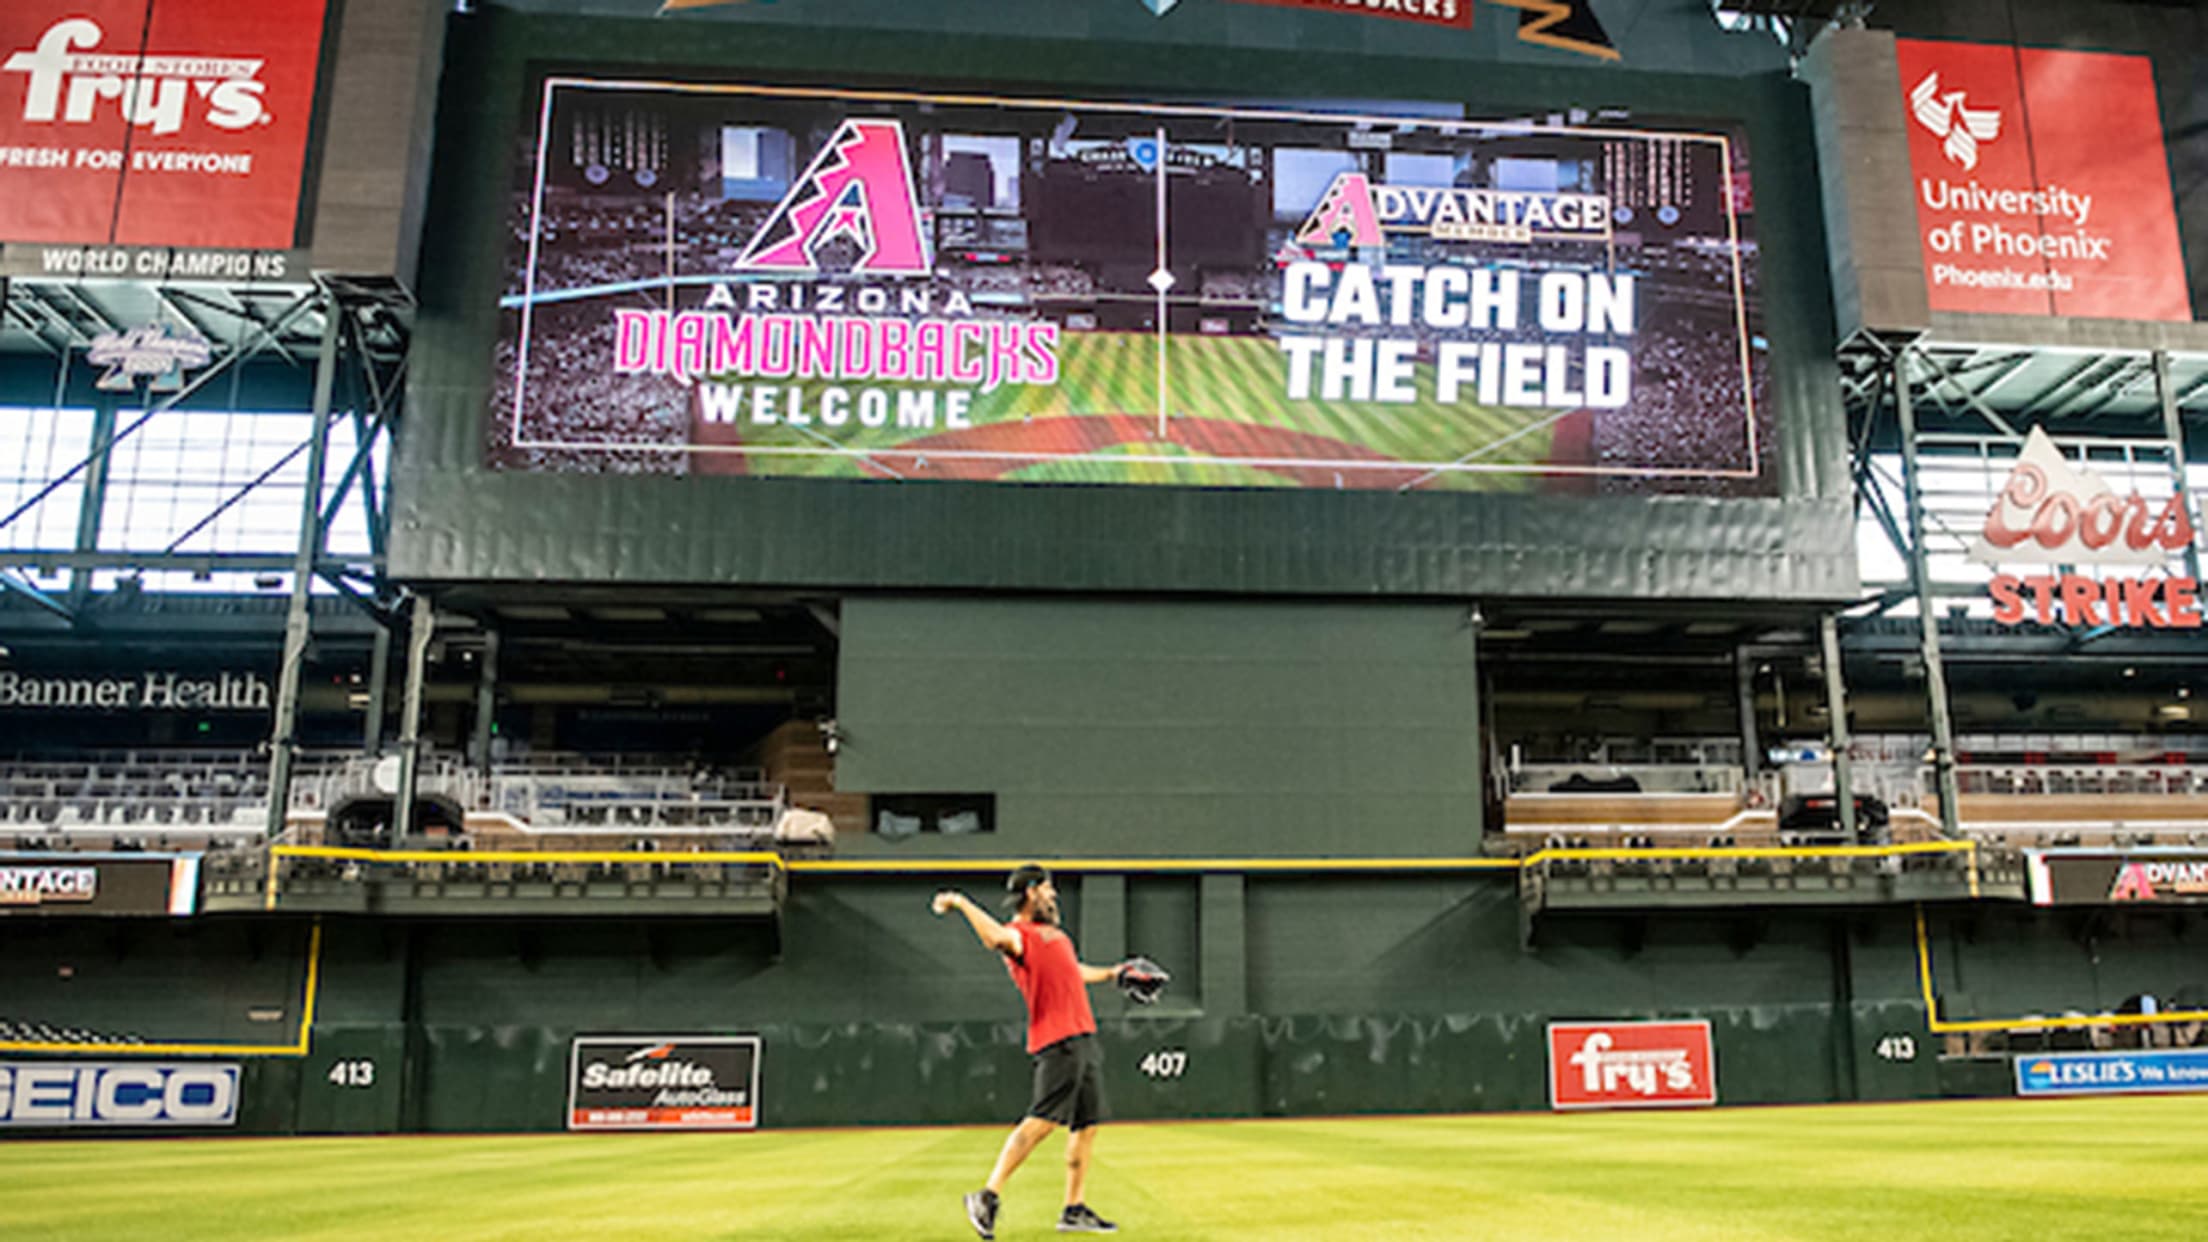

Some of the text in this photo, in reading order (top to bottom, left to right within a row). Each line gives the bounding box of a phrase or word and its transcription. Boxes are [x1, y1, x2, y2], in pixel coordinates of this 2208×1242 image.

[3, 18, 266, 135] fry's
[75, 149, 123, 169] FOR
[132, 152, 253, 173] EVERYONE
[1922, 179, 2091, 225] University
[1929, 221, 1964, 252] of
[43, 249, 286, 277] WORLD CHAMPIONS
[1933, 263, 2073, 291] Phoenix.edu
[705, 283, 973, 315] ARIZONA
[1282, 262, 1634, 335] CATCH ON
[615, 309, 1059, 393] DIAMONDBACKS
[1279, 335, 1630, 408] THE FIELD
[699, 384, 974, 429] WELCOME
[1983, 462, 2195, 549] Coors
[1989, 573, 2203, 627] STRIKE
[0, 671, 270, 709] Banner Health
[1140, 1052, 1187, 1078] 407
[1570, 1032, 1692, 1096] fry's
[1877, 1036, 1915, 1059] 413
[329, 1061, 375, 1086] 413
[582, 1061, 714, 1088] Safelite
[2051, 1058, 2136, 1083] LESLIE'S
[0, 1067, 233, 1121] EICO
